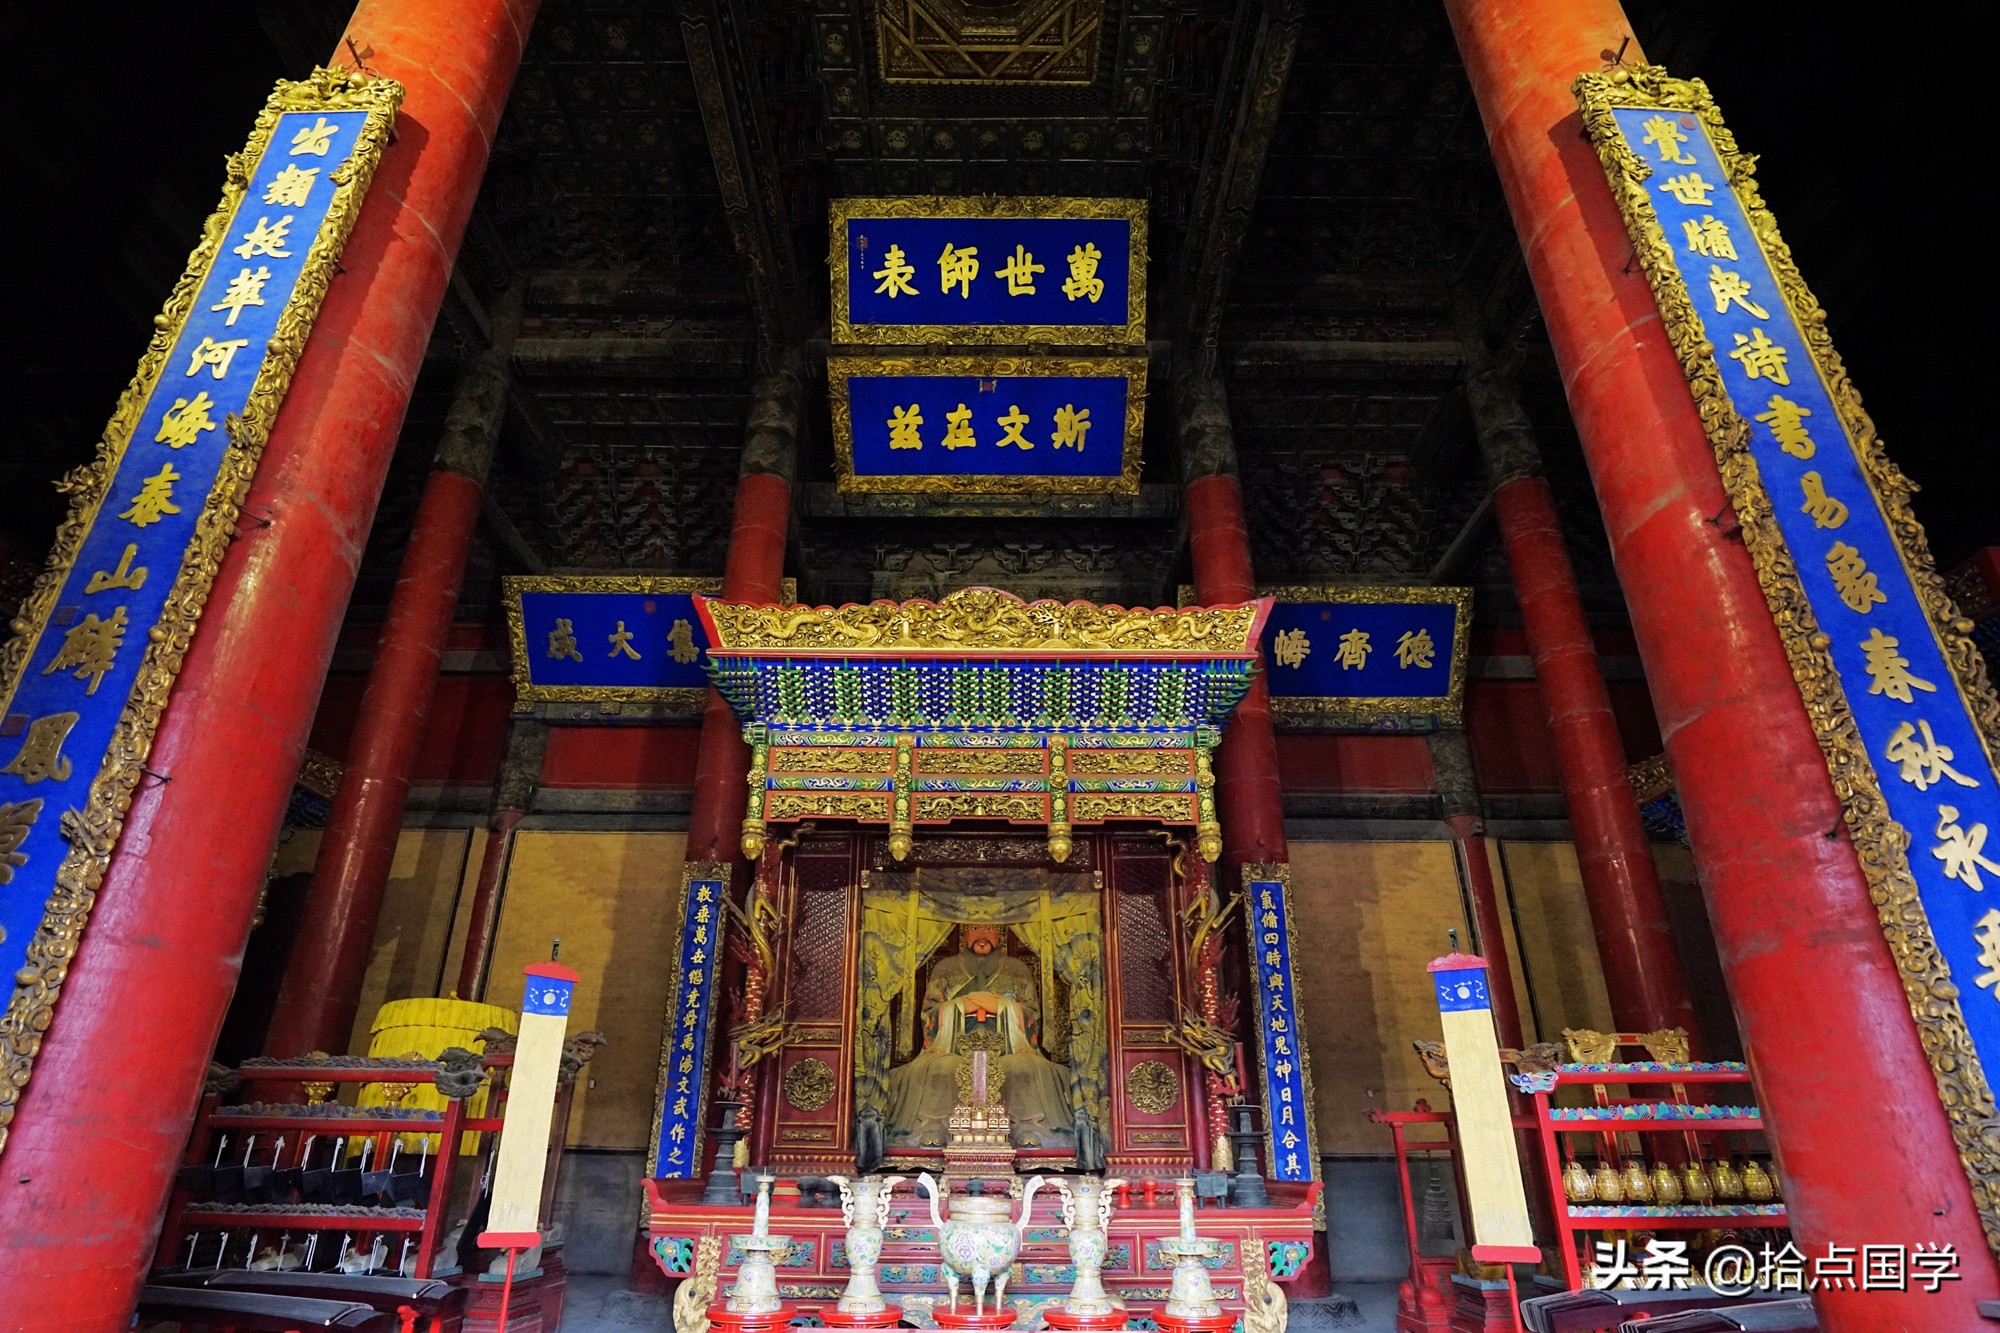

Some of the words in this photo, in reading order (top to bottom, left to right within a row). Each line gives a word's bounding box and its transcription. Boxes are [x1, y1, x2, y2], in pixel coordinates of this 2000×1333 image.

[873, 242, 1104, 303] 萬世師表
[0, 118, 338, 943] 出類拔萃河海泰山麟鳳
[665, 885, 713, 1178] 教垂萬世繼堯舜禹湯文武作之
